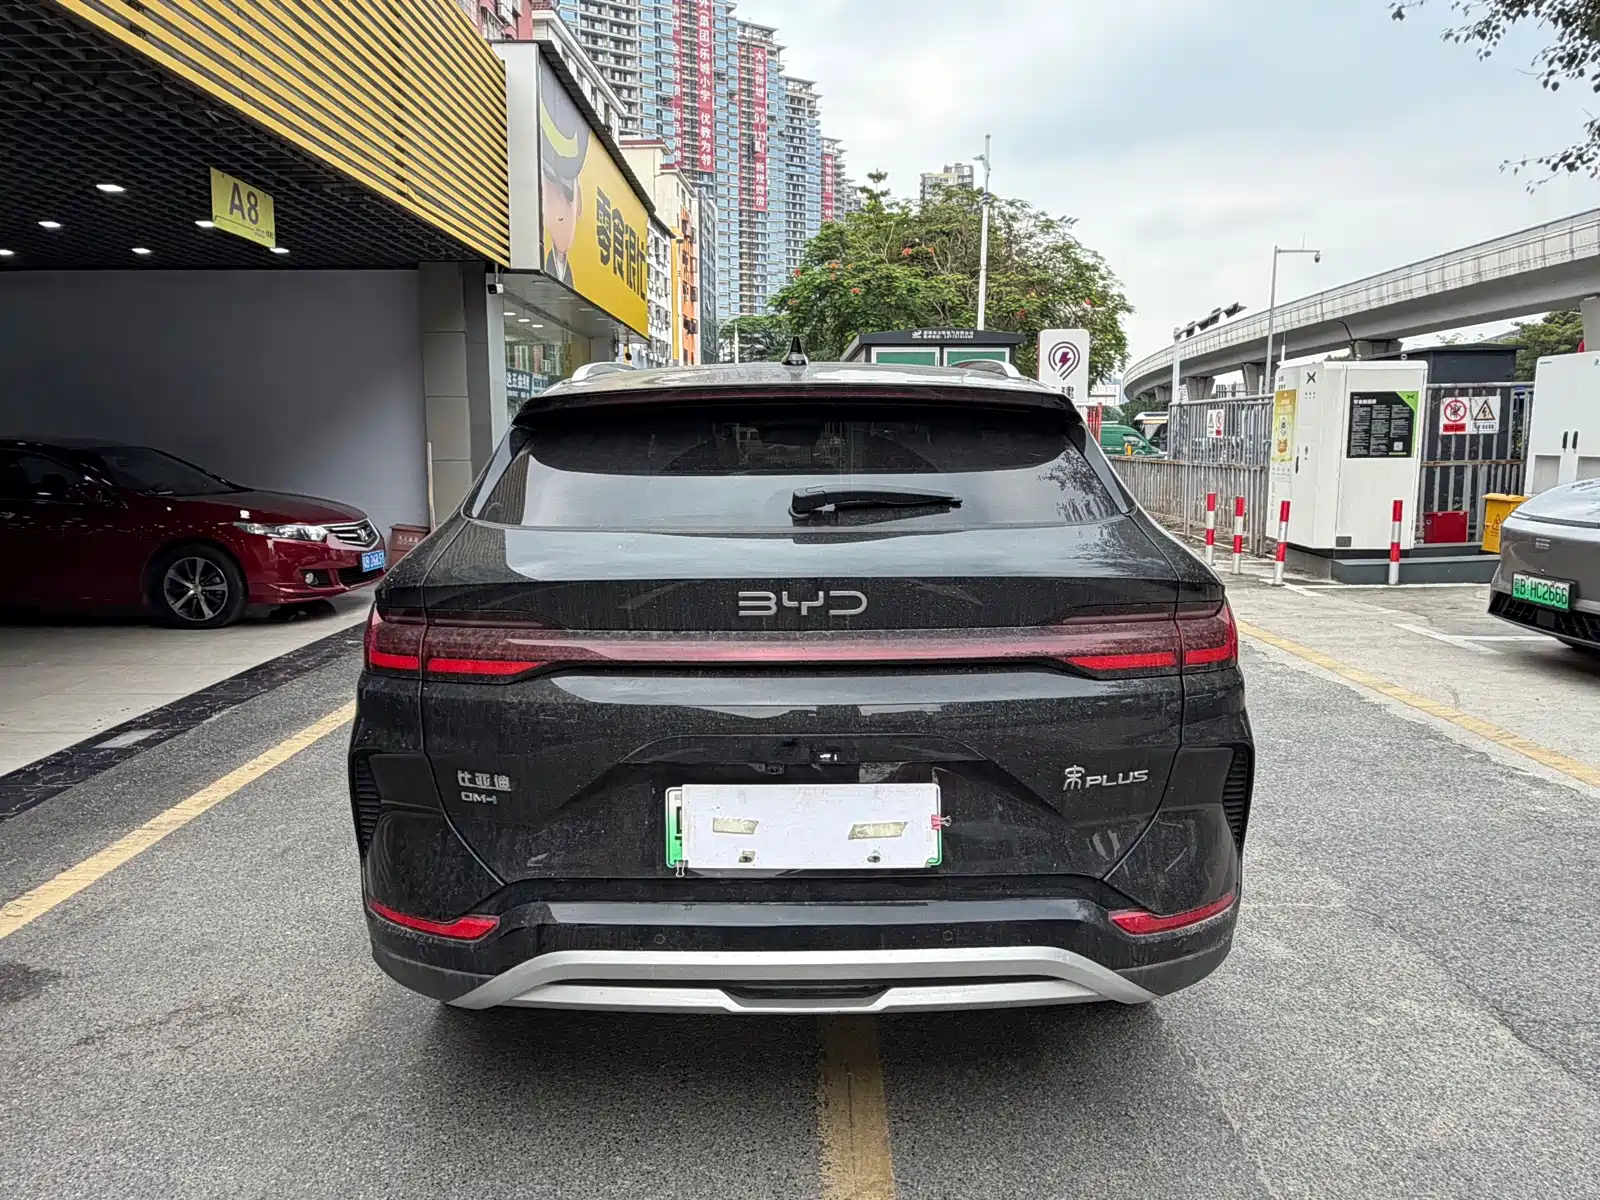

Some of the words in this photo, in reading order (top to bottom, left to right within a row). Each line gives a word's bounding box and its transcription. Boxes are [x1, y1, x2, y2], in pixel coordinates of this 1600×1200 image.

[229, 182, 259, 225] A8
[738, 590, 868, 616] BYD
[457, 769, 512, 791] 比亚迪
